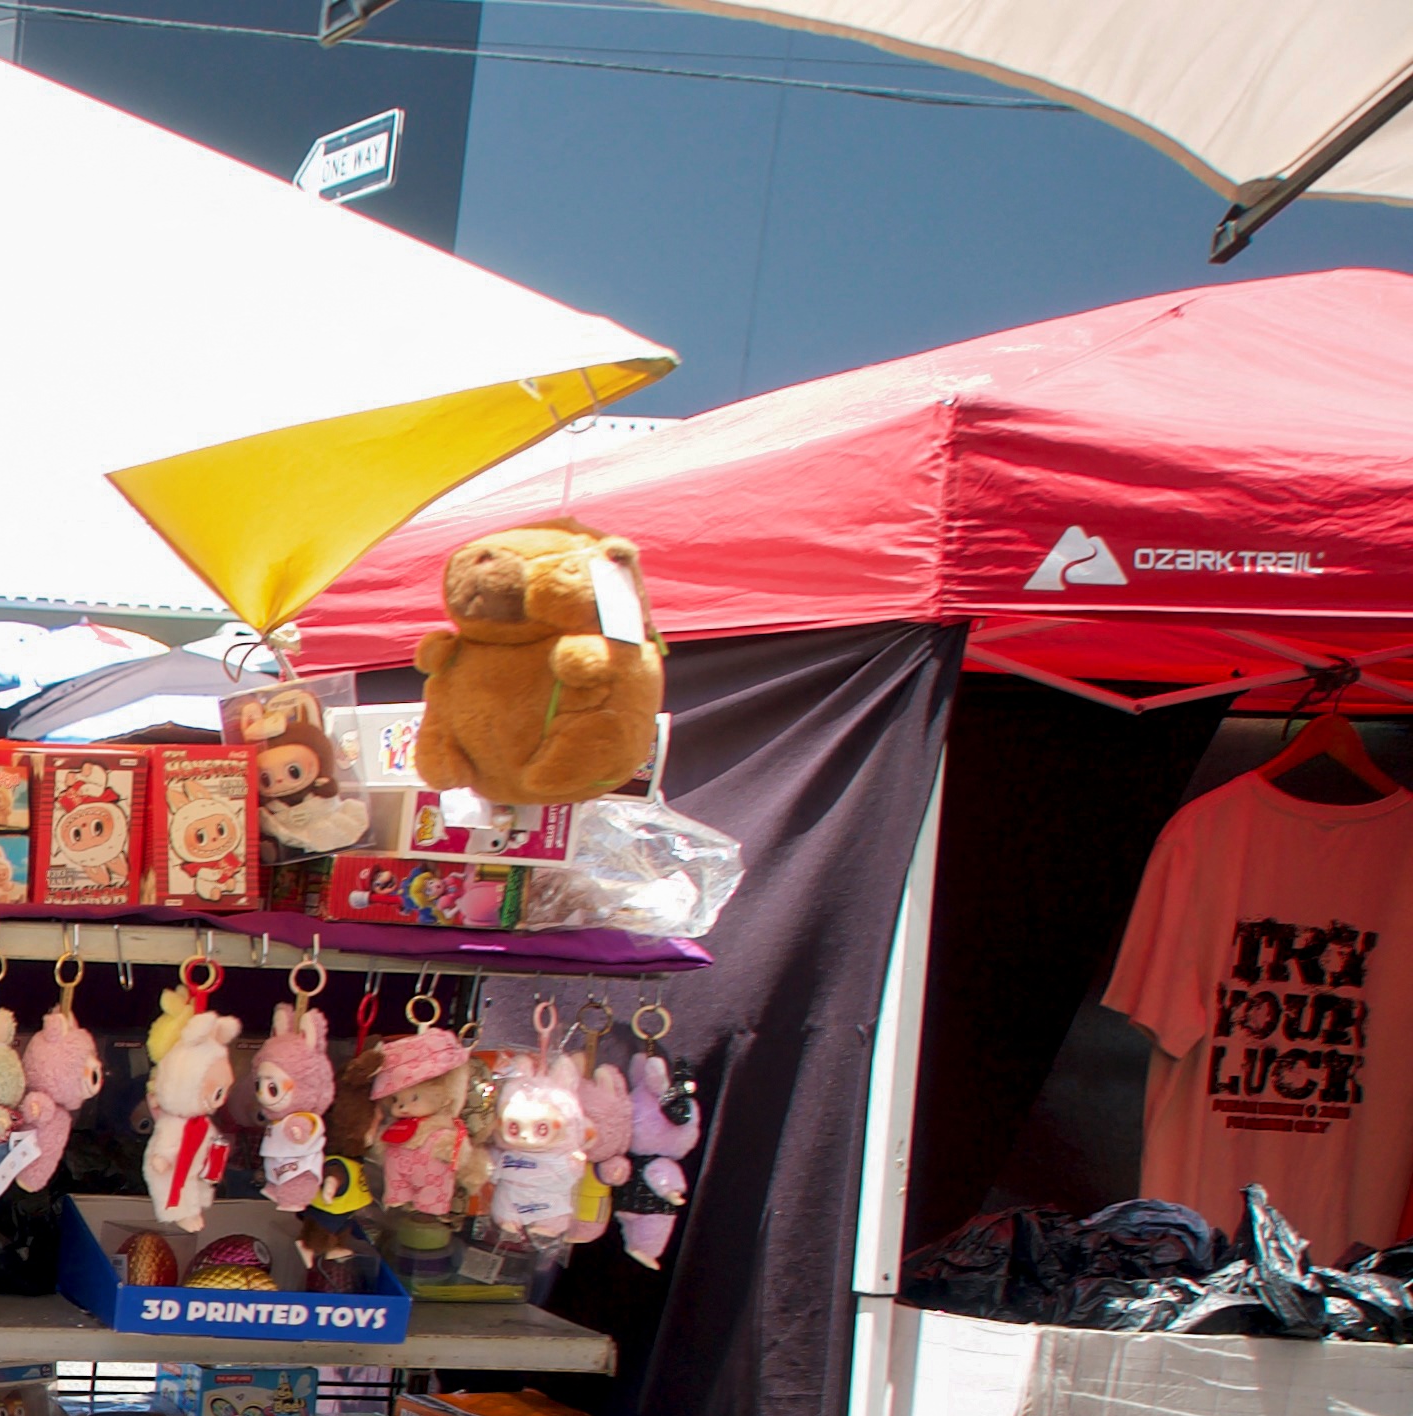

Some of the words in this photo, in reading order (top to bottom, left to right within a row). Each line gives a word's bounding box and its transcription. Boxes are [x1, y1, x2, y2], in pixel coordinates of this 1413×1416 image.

[322, 154, 348, 182] ONE
[354, 142, 382, 172] WAY
[1134, 547, 1235, 572] OZARK
[1238, 550, 1323, 574] TRAIL
[1232, 917, 1378, 989] TRY
[1213, 982, 1370, 1048] YOUR
[1207, 1045, 1365, 1104] LUCK
[142, 1298, 181, 1321] 3D
[186, 1301, 309, 1326] PRINTED
[315, 1304, 387, 1330] TOYS
